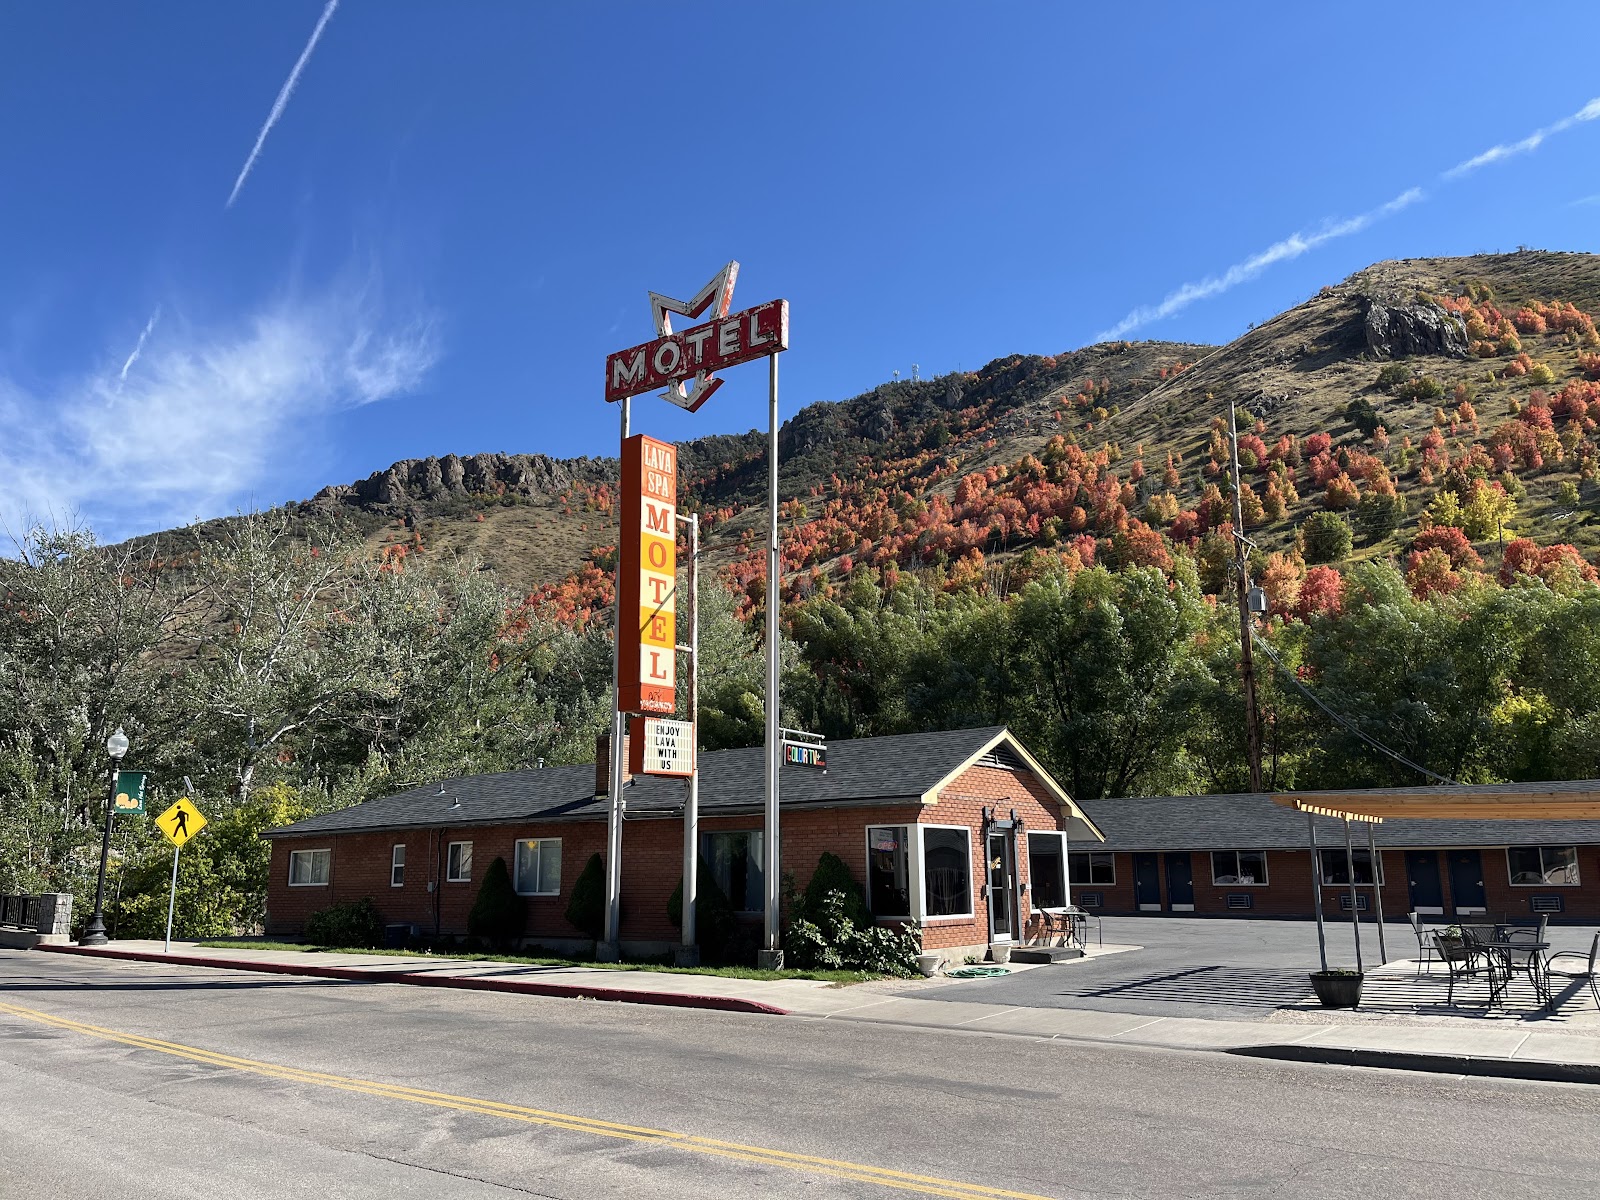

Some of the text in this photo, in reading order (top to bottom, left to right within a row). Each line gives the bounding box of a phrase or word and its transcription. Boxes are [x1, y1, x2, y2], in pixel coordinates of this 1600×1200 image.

[612, 313, 776, 389] MOTEL
[644, 444, 672, 474] LAVA
[648, 471, 669, 498] SPA
[646, 503, 670, 680] MOTEL
[656, 725, 680, 737] ENJOY
[655, 736, 676, 748] LAVA
[658, 748, 677, 759] WITH
[787, 746, 818, 765] COLOR TV
[661, 760, 671, 770] US
[878, 841, 898, 850] OPEN
